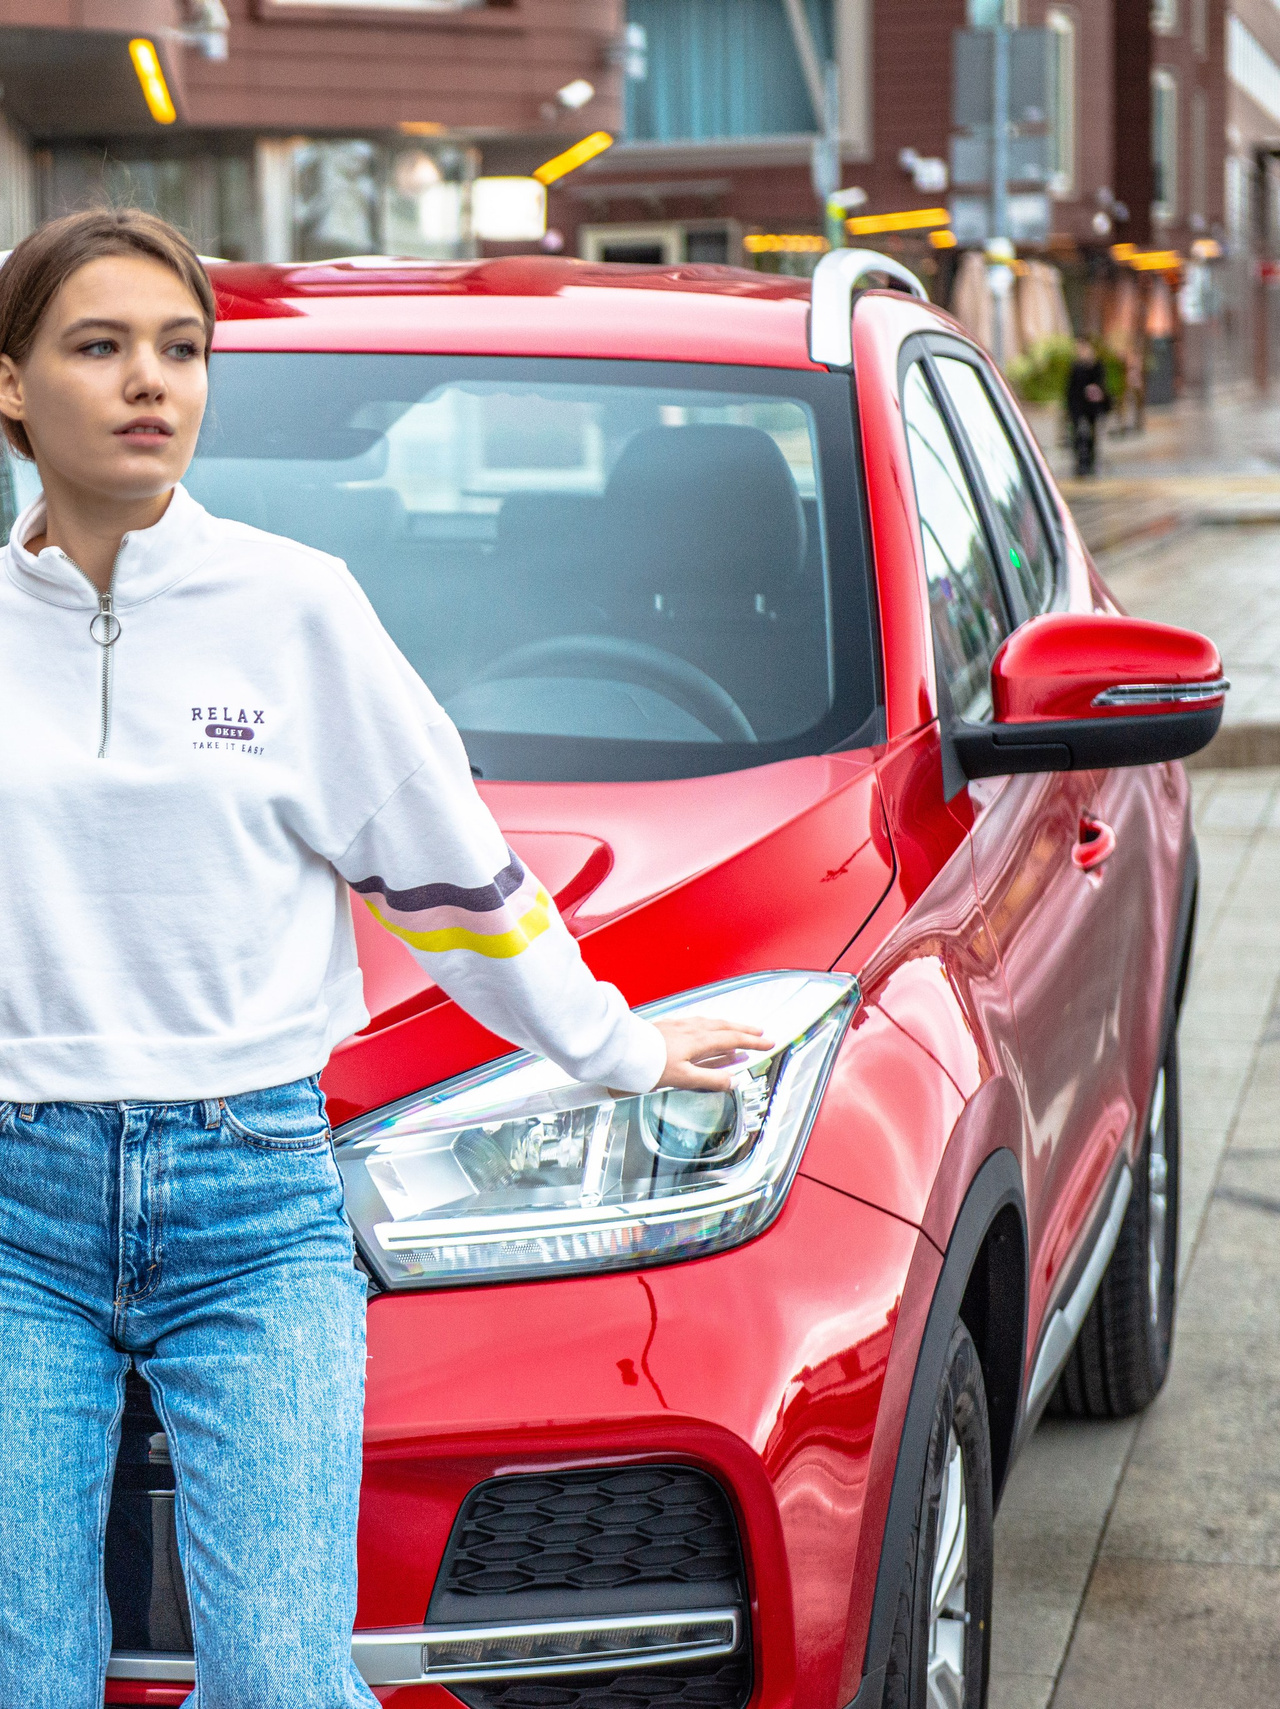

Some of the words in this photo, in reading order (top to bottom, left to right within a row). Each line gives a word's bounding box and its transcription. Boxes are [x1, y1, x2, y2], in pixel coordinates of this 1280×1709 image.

[191, 706, 265, 724] RELAX
[214, 727, 244, 737] OKEY
[192, 741, 220, 750] TAKE
[226, 742, 236, 751] IT
[241, 744, 265, 756] EASY
